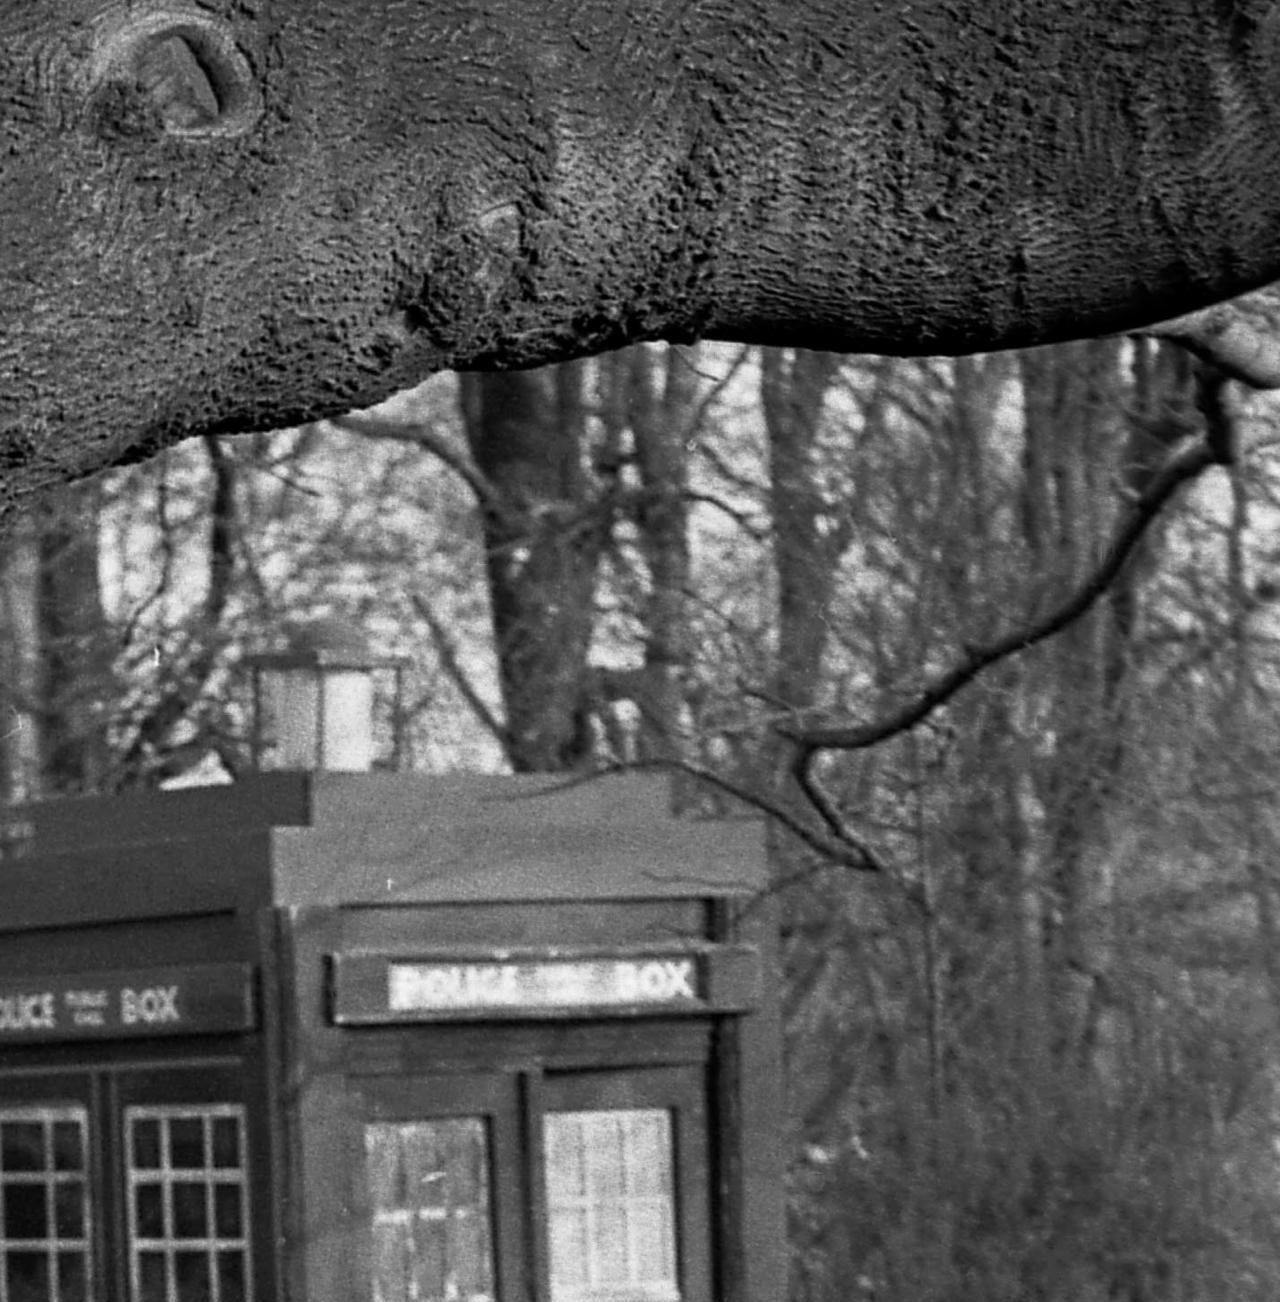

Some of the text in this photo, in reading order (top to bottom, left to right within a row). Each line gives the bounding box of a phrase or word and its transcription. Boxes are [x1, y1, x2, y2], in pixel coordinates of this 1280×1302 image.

[121, 985, 181, 1024] BOX
[391, 965, 519, 1008] POLICE
[614, 962, 694, 1000] BOX
